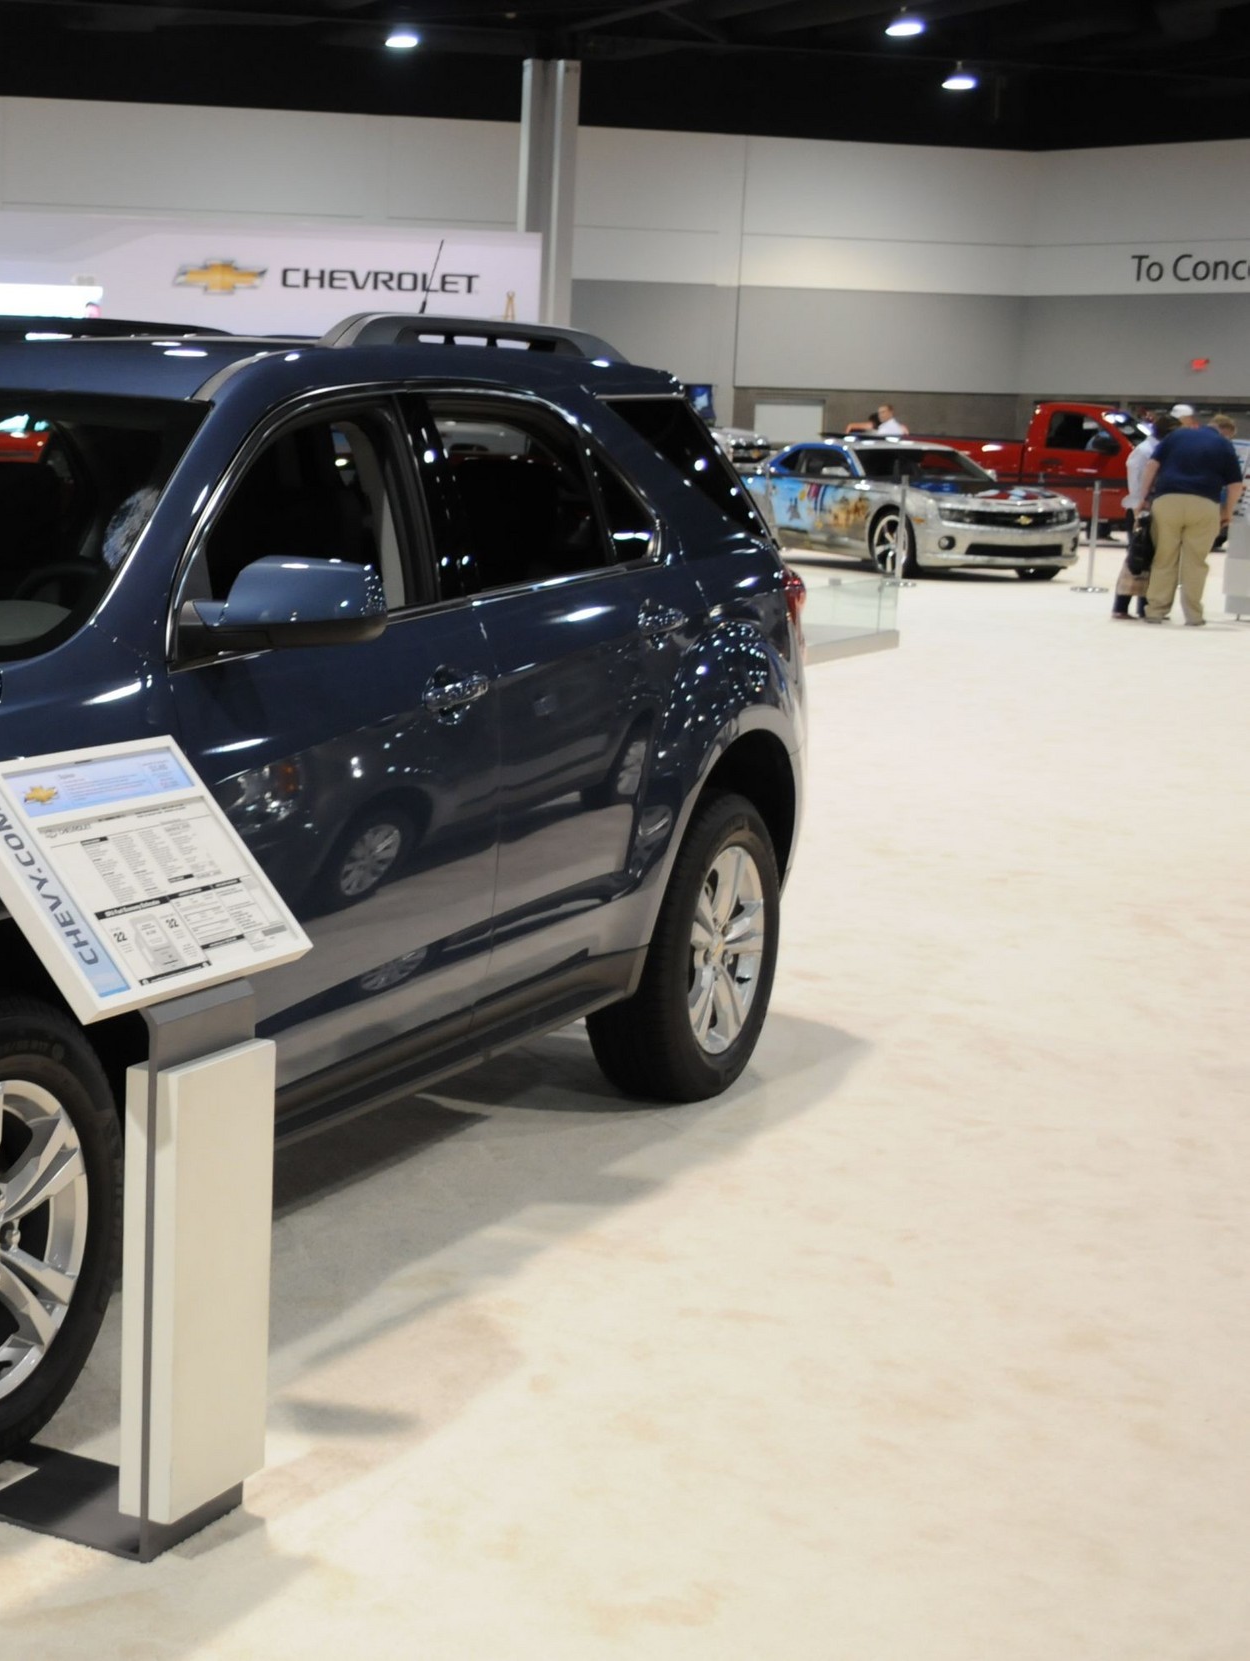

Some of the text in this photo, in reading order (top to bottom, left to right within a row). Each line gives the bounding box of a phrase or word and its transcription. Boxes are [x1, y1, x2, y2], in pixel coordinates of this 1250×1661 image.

[281, 267, 480, 295] CHEVROLET
[1130, 253, 1250, 282] To Conc
